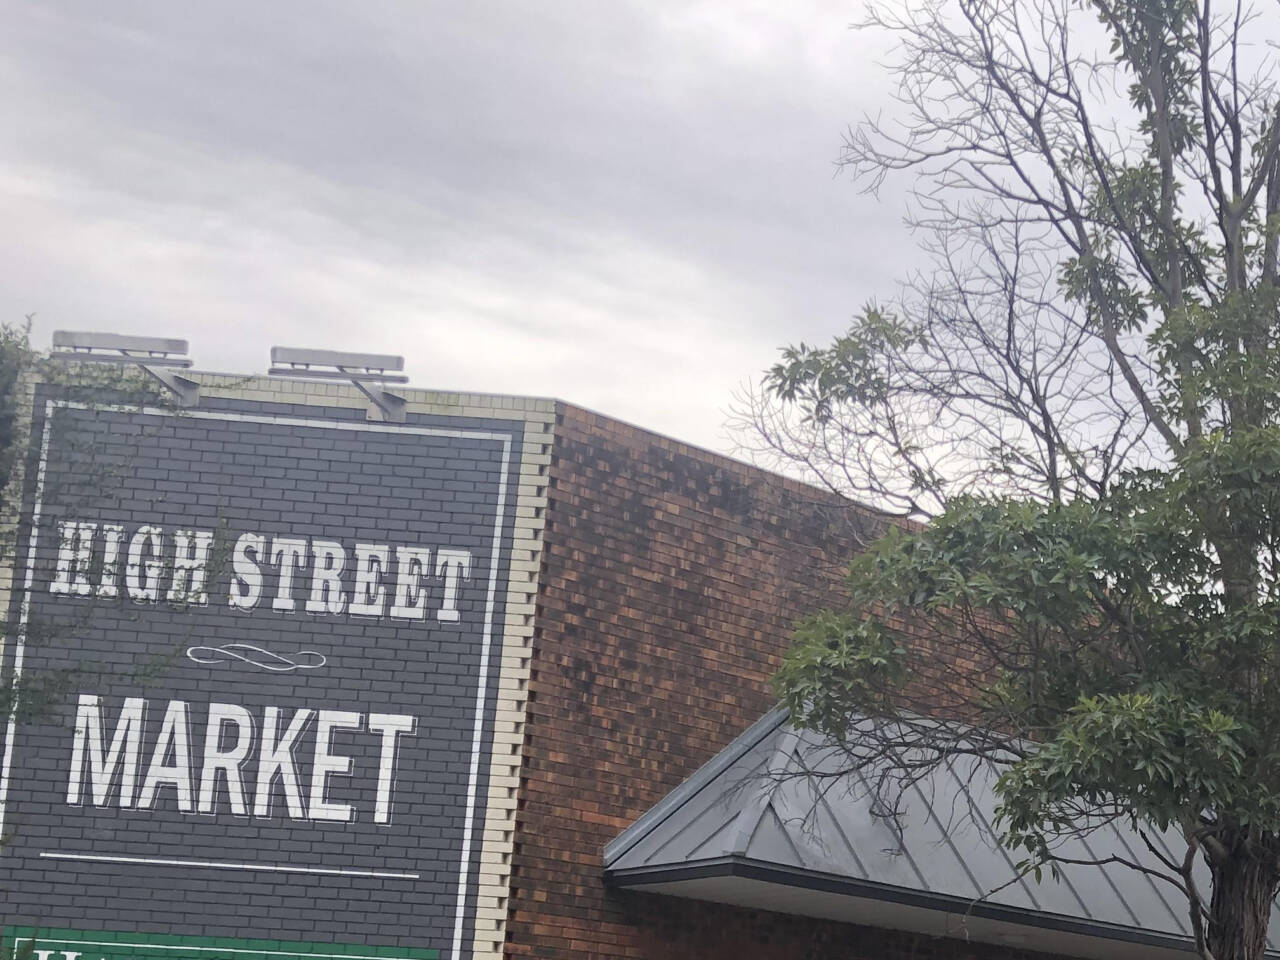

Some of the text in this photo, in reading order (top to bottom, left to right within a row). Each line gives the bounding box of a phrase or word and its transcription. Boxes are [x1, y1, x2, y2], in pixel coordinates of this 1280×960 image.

[49, 520, 472, 624] HIGH STREET
[66, 694, 418, 826] MARKET
